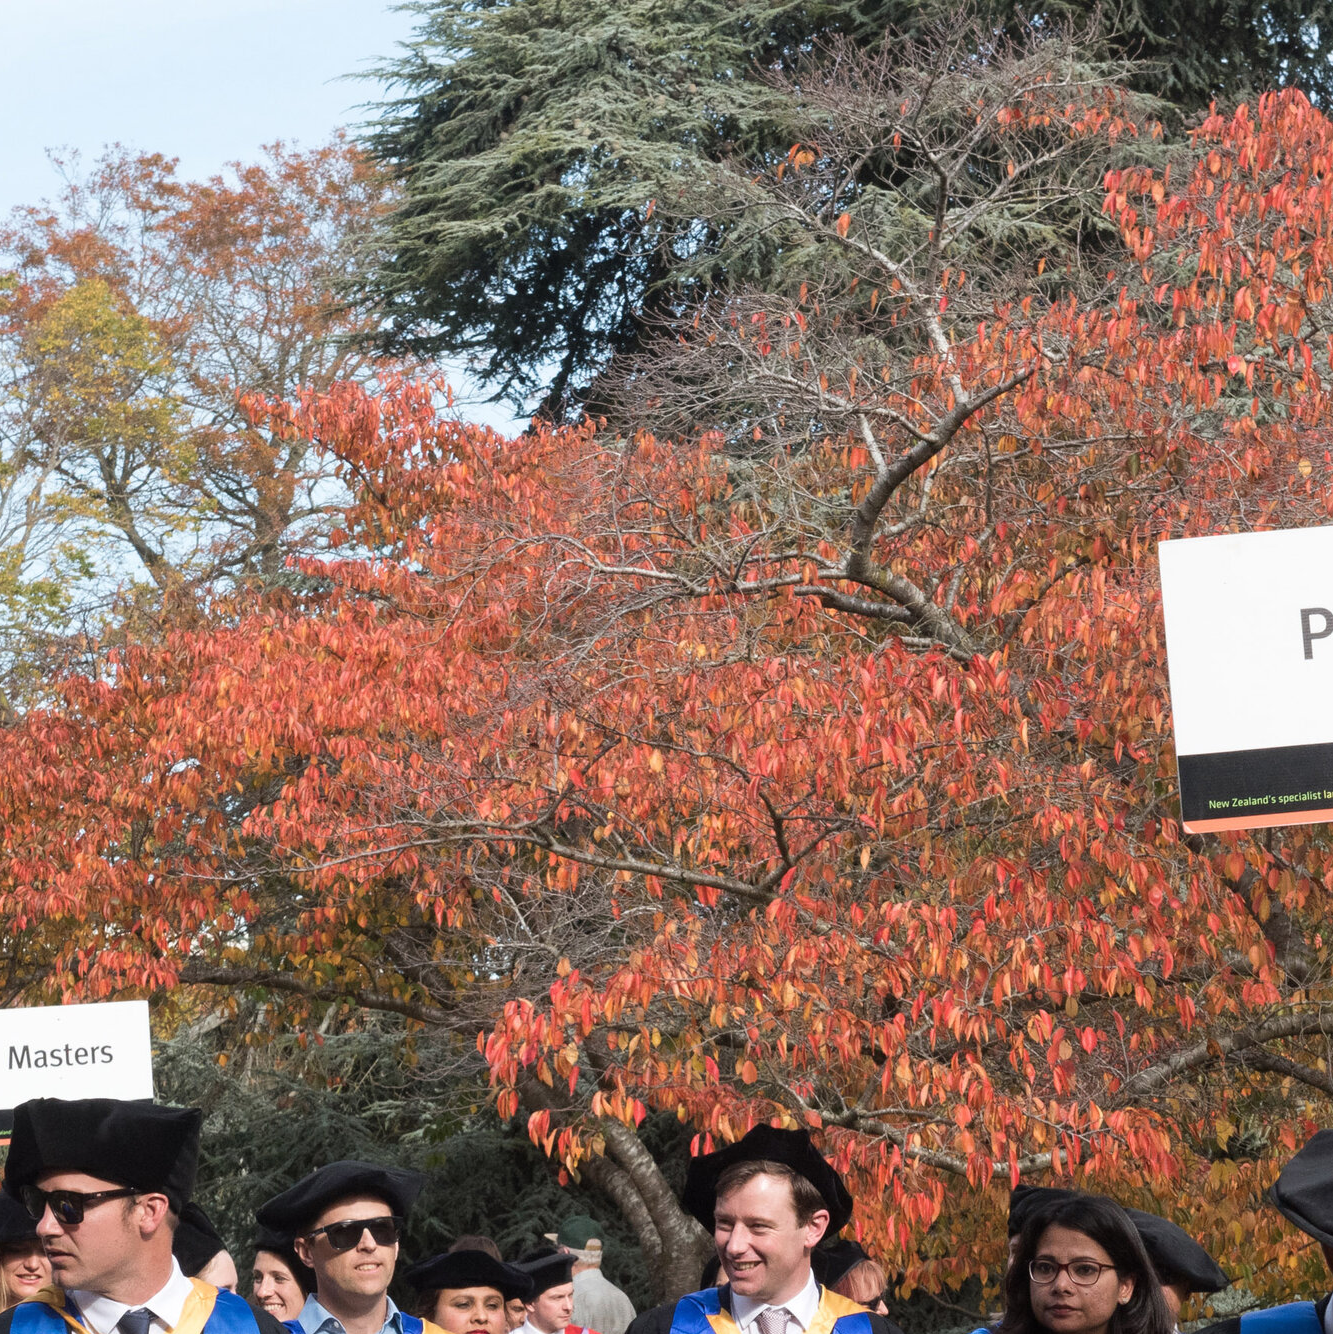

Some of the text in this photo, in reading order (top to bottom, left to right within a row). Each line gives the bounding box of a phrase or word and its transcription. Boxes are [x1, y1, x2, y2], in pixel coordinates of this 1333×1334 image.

[1209, 800, 1230, 809] New
[1232, 795, 1276, 807] Zealand's
[1278, 791, 1322, 804] specialist
[8, 1043, 113, 1070] Masters
